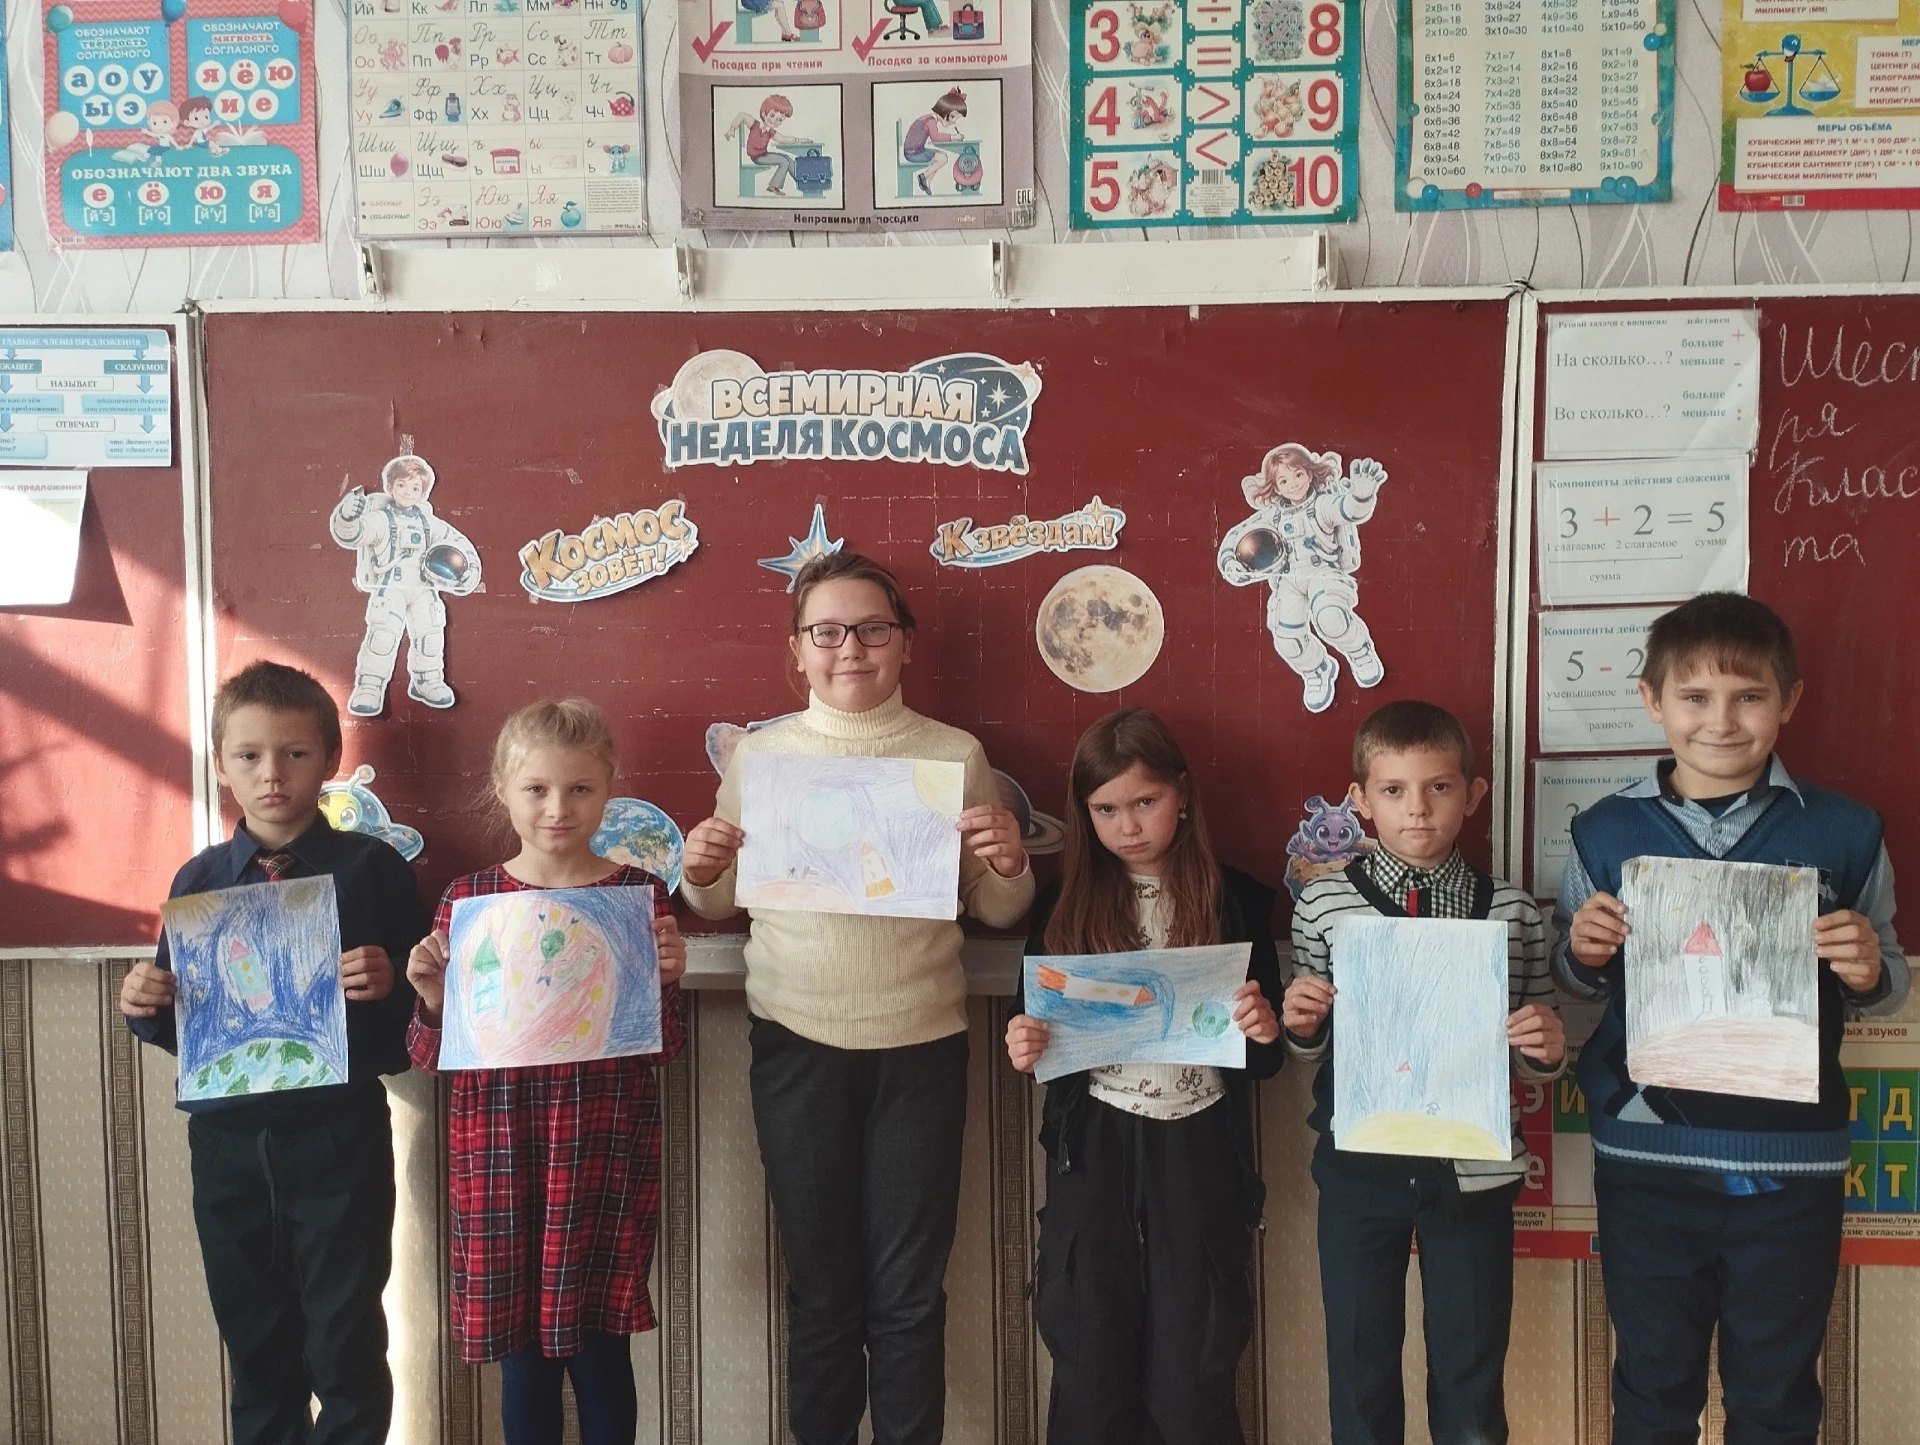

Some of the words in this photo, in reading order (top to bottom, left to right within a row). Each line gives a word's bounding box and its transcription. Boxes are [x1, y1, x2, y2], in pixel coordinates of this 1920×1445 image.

[412, 2, 428, 14] Кк
[1809, 6, 1828, 14] (ММ)
[75, 26, 151, 37] ОБОЗНАЧАЮТ
[203, 22, 280, 32] ОБОЗНАЧАЮТ
[1307, 3, 1341, 56] 8
[1088, 8, 1120, 63] 3
[76, 49, 151, 60] СОГЛАСНОГО
[204, 45, 280, 56] СОГЛАСНОГО
[413, 55, 432, 67] Пп
[470, 54, 489, 69] Рр
[527, 53, 547, 66] Сс
[585, 52, 602, 64] Тт
[711, 58, 757, 71] Посадка
[761, 60, 783, 72] при
[786, 58, 823, 70] чтении
[867, 55, 915, 67] Посадка
[918, 55, 932, 66] за
[935, 52, 1008, 65] компьютером
[237, 62, 254, 83] ё
[1087, 85, 1121, 136] 4
[1307, 78, 1339, 131] 9
[356, 110, 373, 125] Уу
[413, 108, 438, 124] Фф
[471, 108, 489, 120] Хх
[529, 106, 549, 122] Цц
[586, 105, 604, 118] Чч
[1817, 124, 1847, 132] МЕРЫ
[1849, 122, 1892, 132] ОБЪЁМА
[1748, 138, 1801, 146] КУБИЧЕСКИЙ
[1803, 138, 1826, 146] МЕТР
[1747, 149, 1801, 157] КУБИЧЕСКИЙ
[1803, 149, 1848, 158] ДЕЦИМЕТР
[1747, 161, 1801, 169] КУБИЧЕСКИЙ
[1802, 161, 1852, 169] САНТИМЕТР
[71, 167, 193, 180] ОБОЗНАЧАЮТ
[198, 166, 232, 179] ДВА
[237, 164, 293, 177] ЗВУКА
[359, 165, 386, 177] Шш
[417, 164, 445, 179] Щщ
[1747, 172, 1800, 180] КУБИЧЕСКИЙ
[1802, 172, 1854, 180] МИЛЛИМЕТР
[1089, 160, 1121, 212] 5
[1287, 155, 1339, 207] 10
[146, 183, 162, 202] ё
[418, 218, 437, 230] Ээ
[475, 217, 502, 229] Юю
[533, 216, 552, 228] Яя
[793, 213, 872, 225] Неправильная
[1627, 319, 1668, 327] вопросом
[74, 338, 141, 347] ПРЕДЛОЖЕНИЯ
[1681, 338, 1724, 348] больше
[115, 362, 165, 371] СКАЗУЕМОЕ
[1556, 354, 1577, 367] На
[1680, 357, 1725, 366] меньше
[50, 380, 98, 388] НАЗЫВАЕТ
[711, 373, 974, 425] ВСЕМИРНАЯ
[1683, 390, 1726, 399] больше
[1554, 407, 1575, 420] Во
[1681, 409, 1727, 418] меньше
[56, 421, 100, 429] ОТВЕЧАЕТ
[670, 419, 823, 462] НЕДЕЛЯ
[831, 418, 1025, 470] КОСМОСА
[1549, 479, 1619, 489] Компоненты
[1621, 477, 1673, 487] действия
[1676, 474, 1730, 483] сложения
[17, 484, 83, 492] предложения
[1560, 507, 1578, 539] 3
[1633, 504, 1654, 536] 2
[1706, 501, 1725, 533] 5
[942, 519, 973, 563] К
[973, 516, 1116, 553] звёздам!
[1554, 543, 1606, 552] слагаемое
[1615, 540, 1622, 549] 2
[1624, 540, 1678, 550] слагаемое
[1694, 538, 1727, 547] сумма
[1589, 573, 1622, 583] сумма
[1544, 626, 1614, 637] Компоненты
[1566, 650, 1584, 682] 5
[1625, 647, 1645, 680] 2
[1546, 688, 1617, 699] уменьшаемое
[1588, 721, 1634, 732] разность
[1542, 775, 1611, 786] Компоненты
[1867, 1027, 1908, 1038] звуков
[1560, 1079, 1586, 1114] И
[1882, 1086, 1913, 1131] Д
[1884, 1163, 1908, 1198] Т
